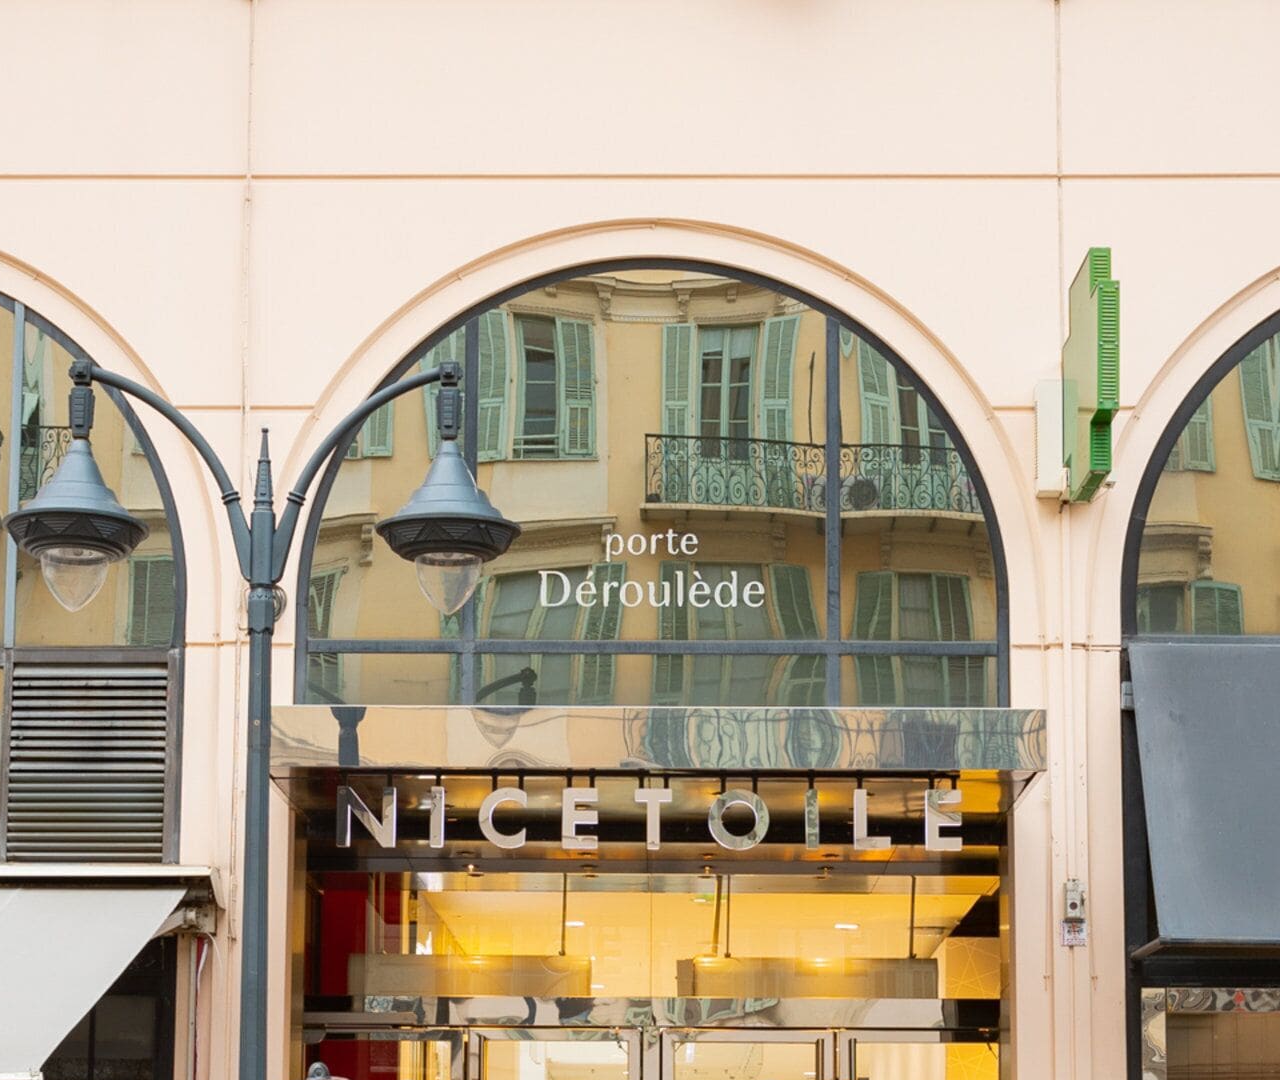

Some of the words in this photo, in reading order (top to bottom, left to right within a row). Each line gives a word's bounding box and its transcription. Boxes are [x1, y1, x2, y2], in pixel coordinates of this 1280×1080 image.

[605, 528, 699, 562] porte
[538, 569, 766, 608] Déroulède
[336, 787, 963, 851] NICETOILE
